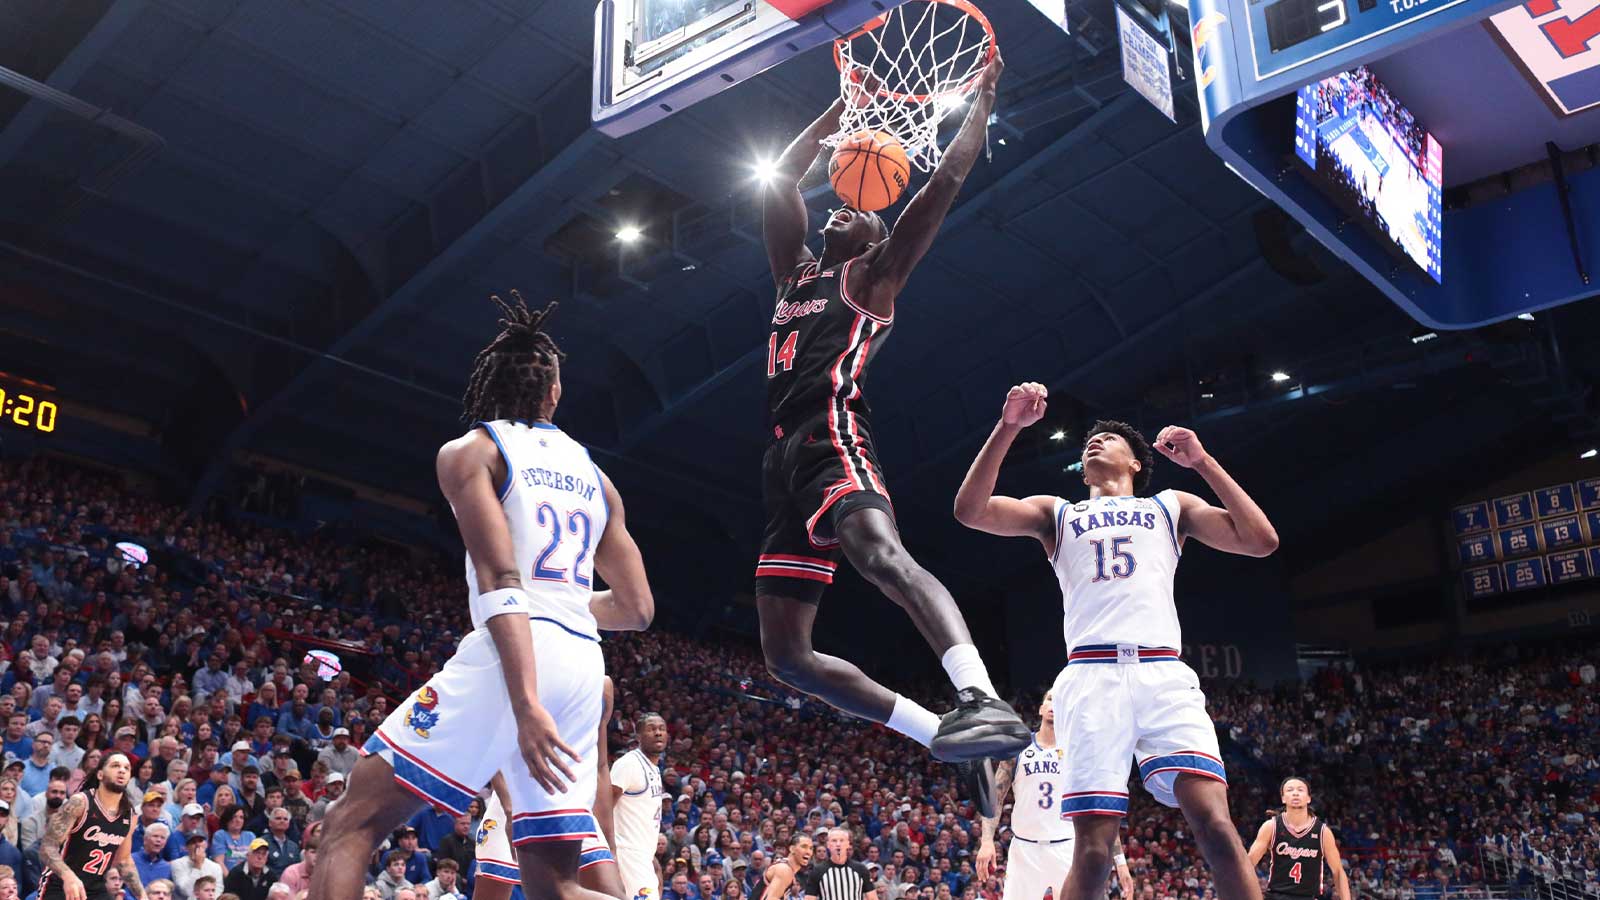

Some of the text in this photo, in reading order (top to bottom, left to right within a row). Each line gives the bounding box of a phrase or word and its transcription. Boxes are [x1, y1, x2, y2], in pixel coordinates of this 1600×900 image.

[767, 330, 800, 377] 14
[521, 468, 596, 502] PETERSON
[1466, 513, 1475, 526] 7
[1506, 503, 1521, 518] 12
[1069, 510, 1156, 539] KANSAS
[1553, 526, 1569, 541] 13
[532, 501, 591, 590] 22
[1510, 534, 1528, 549] 25
[1089, 535, 1138, 583] 15
[1561, 559, 1577, 574] 15
[1474, 575, 1491, 590] 23
[1516, 567, 1534, 582] 25
[1038, 781, 1054, 810] 3
[83, 849, 112, 875] 21
[1289, 862, 1303, 885] 4
